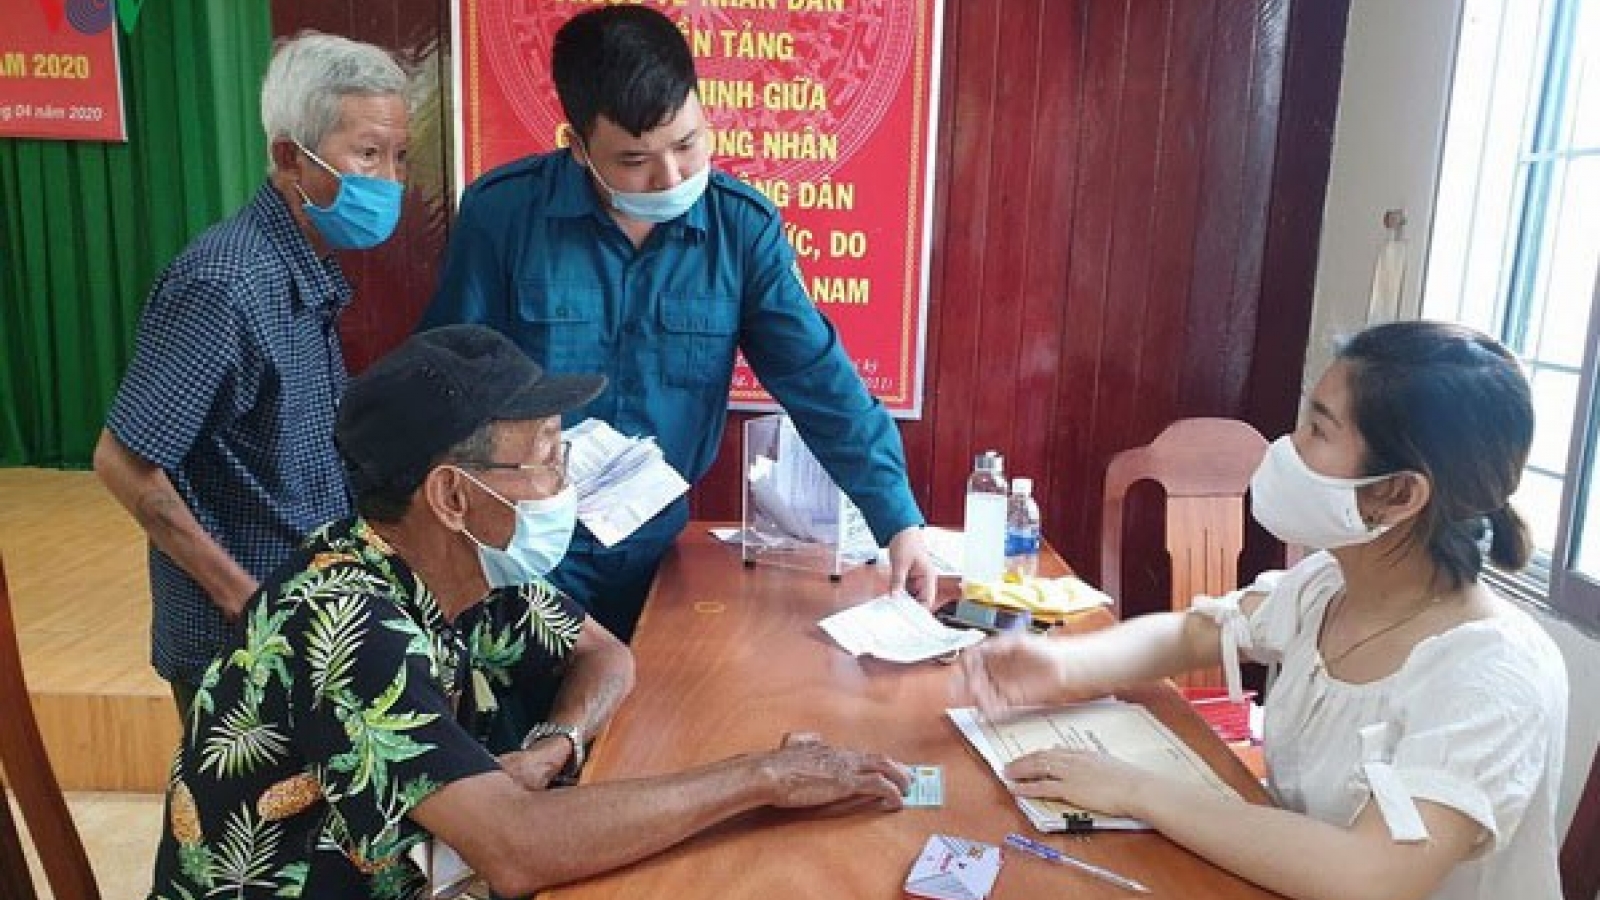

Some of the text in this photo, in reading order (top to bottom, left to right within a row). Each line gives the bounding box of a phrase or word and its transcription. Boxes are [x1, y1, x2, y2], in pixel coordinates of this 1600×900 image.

[720, 19, 794, 60] TẢNG
[32, 53, 89, 79] 2020
[764, 75, 827, 111] GIỮA
[763, 125, 838, 162] NHÂN
[798, 174, 854, 210] DÂN
[830, 230, 867, 258] DO
[812, 276, 869, 305] NAM
